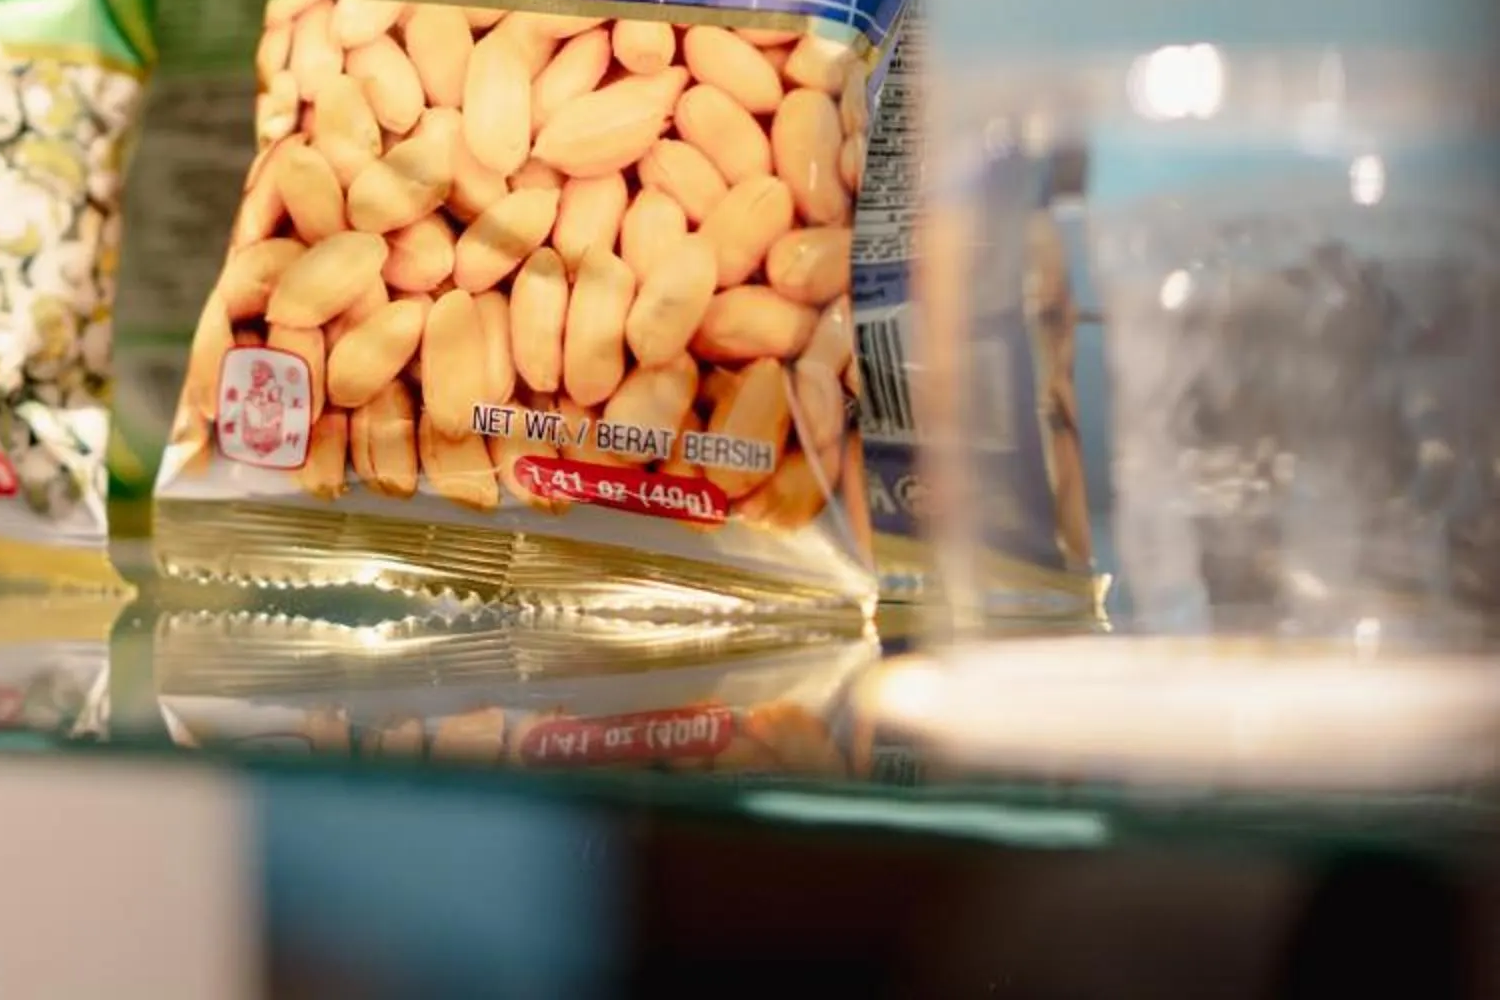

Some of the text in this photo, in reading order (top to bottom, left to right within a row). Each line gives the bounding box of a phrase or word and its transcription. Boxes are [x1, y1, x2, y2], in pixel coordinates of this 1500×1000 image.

[472, 405, 515, 435] NET
[596, 423, 673, 458] BERAT
[683, 433, 773, 470] BERSIH
[526, 464, 585, 492] 1.41
[596, 480, 627, 502] oz
